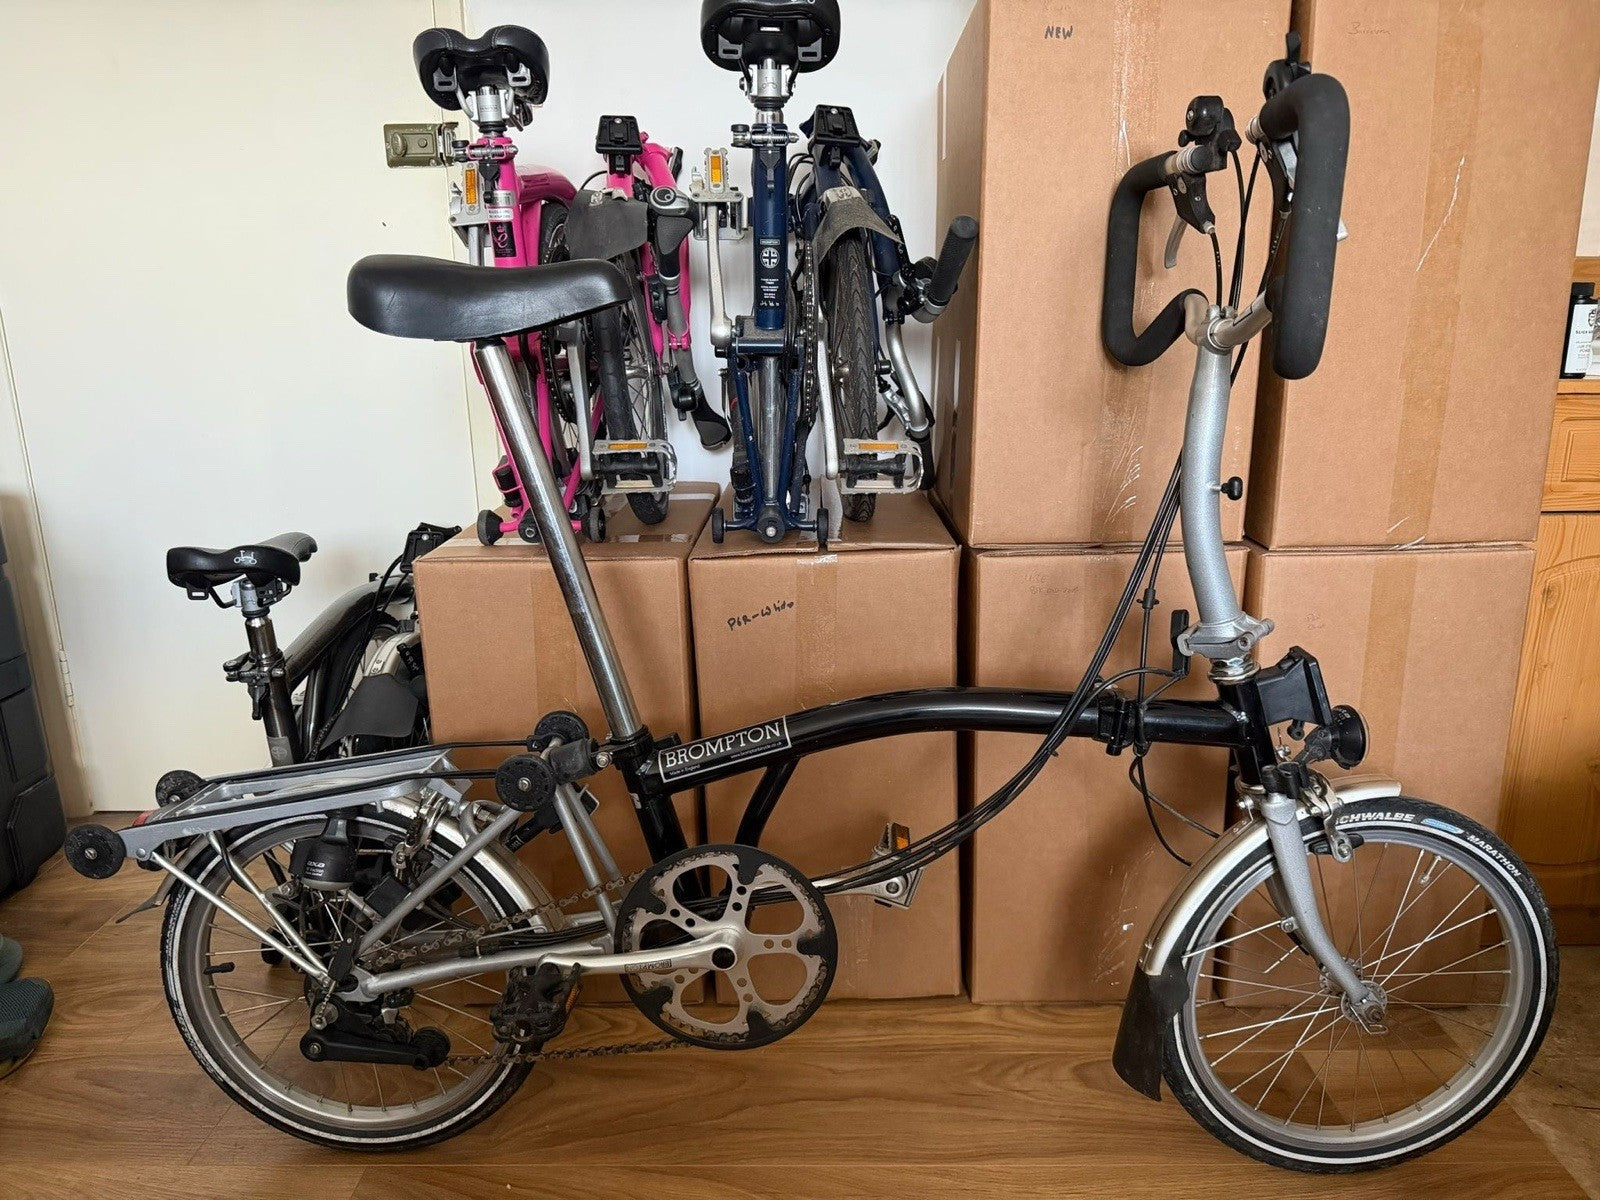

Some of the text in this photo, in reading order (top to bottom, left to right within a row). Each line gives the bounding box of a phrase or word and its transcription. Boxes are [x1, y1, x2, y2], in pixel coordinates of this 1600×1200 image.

[1044, 25, 1073, 40] NEW
[665, 722, 781, 768] BROMPTON
[1466, 834, 1522, 877] MARATHON
